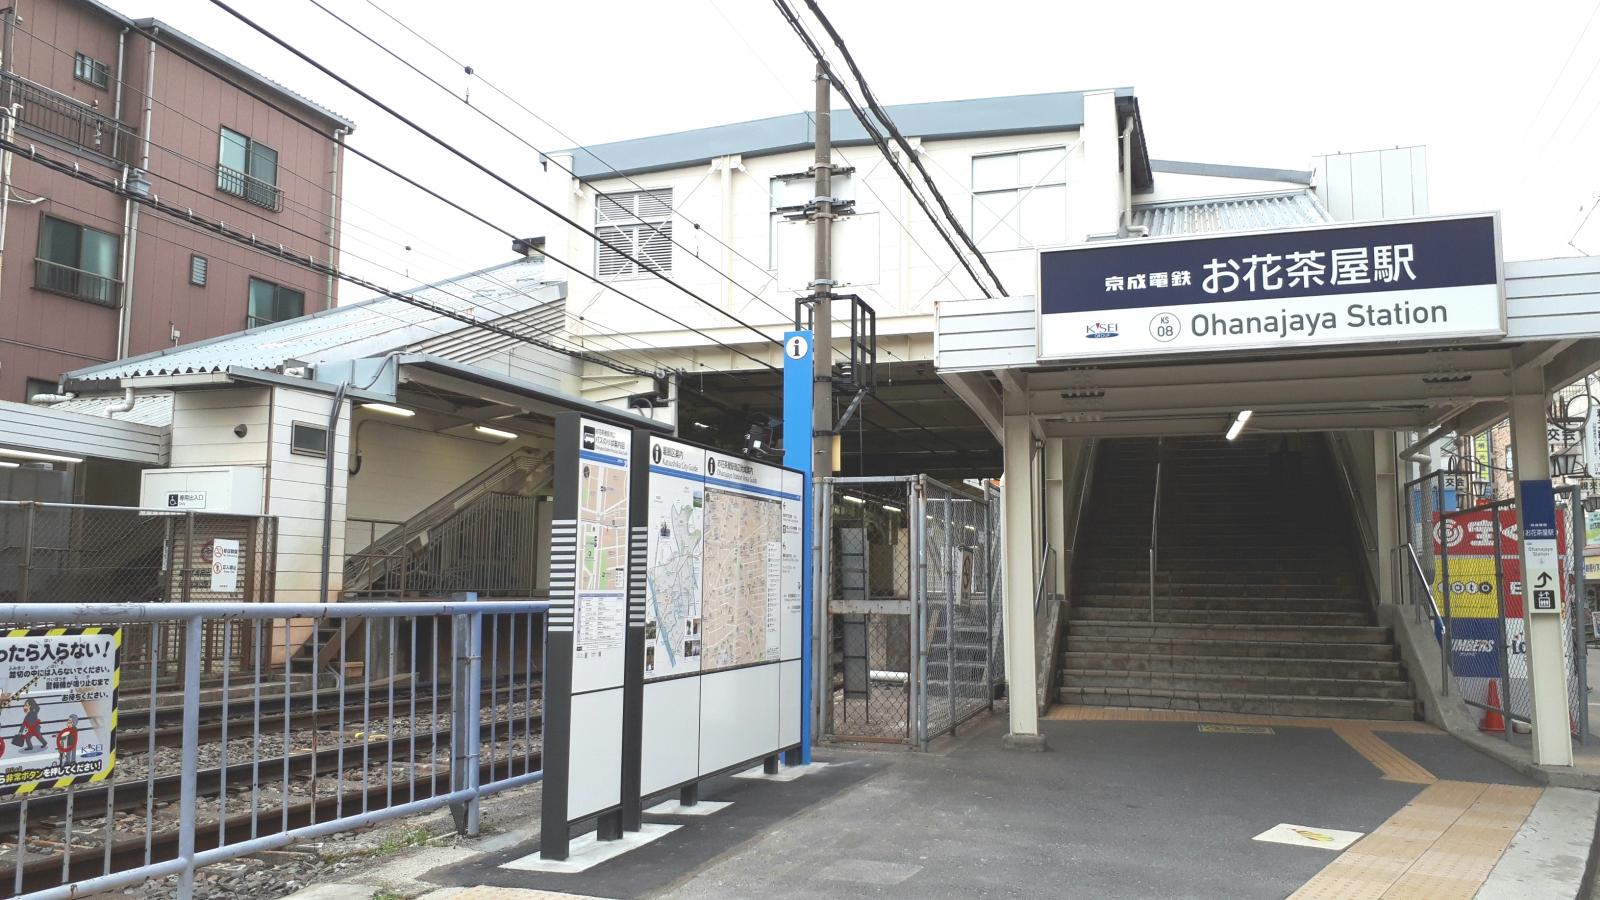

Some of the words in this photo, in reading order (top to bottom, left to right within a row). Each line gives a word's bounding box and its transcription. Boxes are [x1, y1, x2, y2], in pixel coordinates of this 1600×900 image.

[1104, 270, 1192, 292] 京成電鉄
[1201, 243, 1417, 294] お花茶屋駅
[1157, 325, 1174, 337] 08
[1160, 316, 1170, 324] KS
[1191, 308, 1338, 339] Ohanajaya
[1347, 301, 1448, 329] Station
